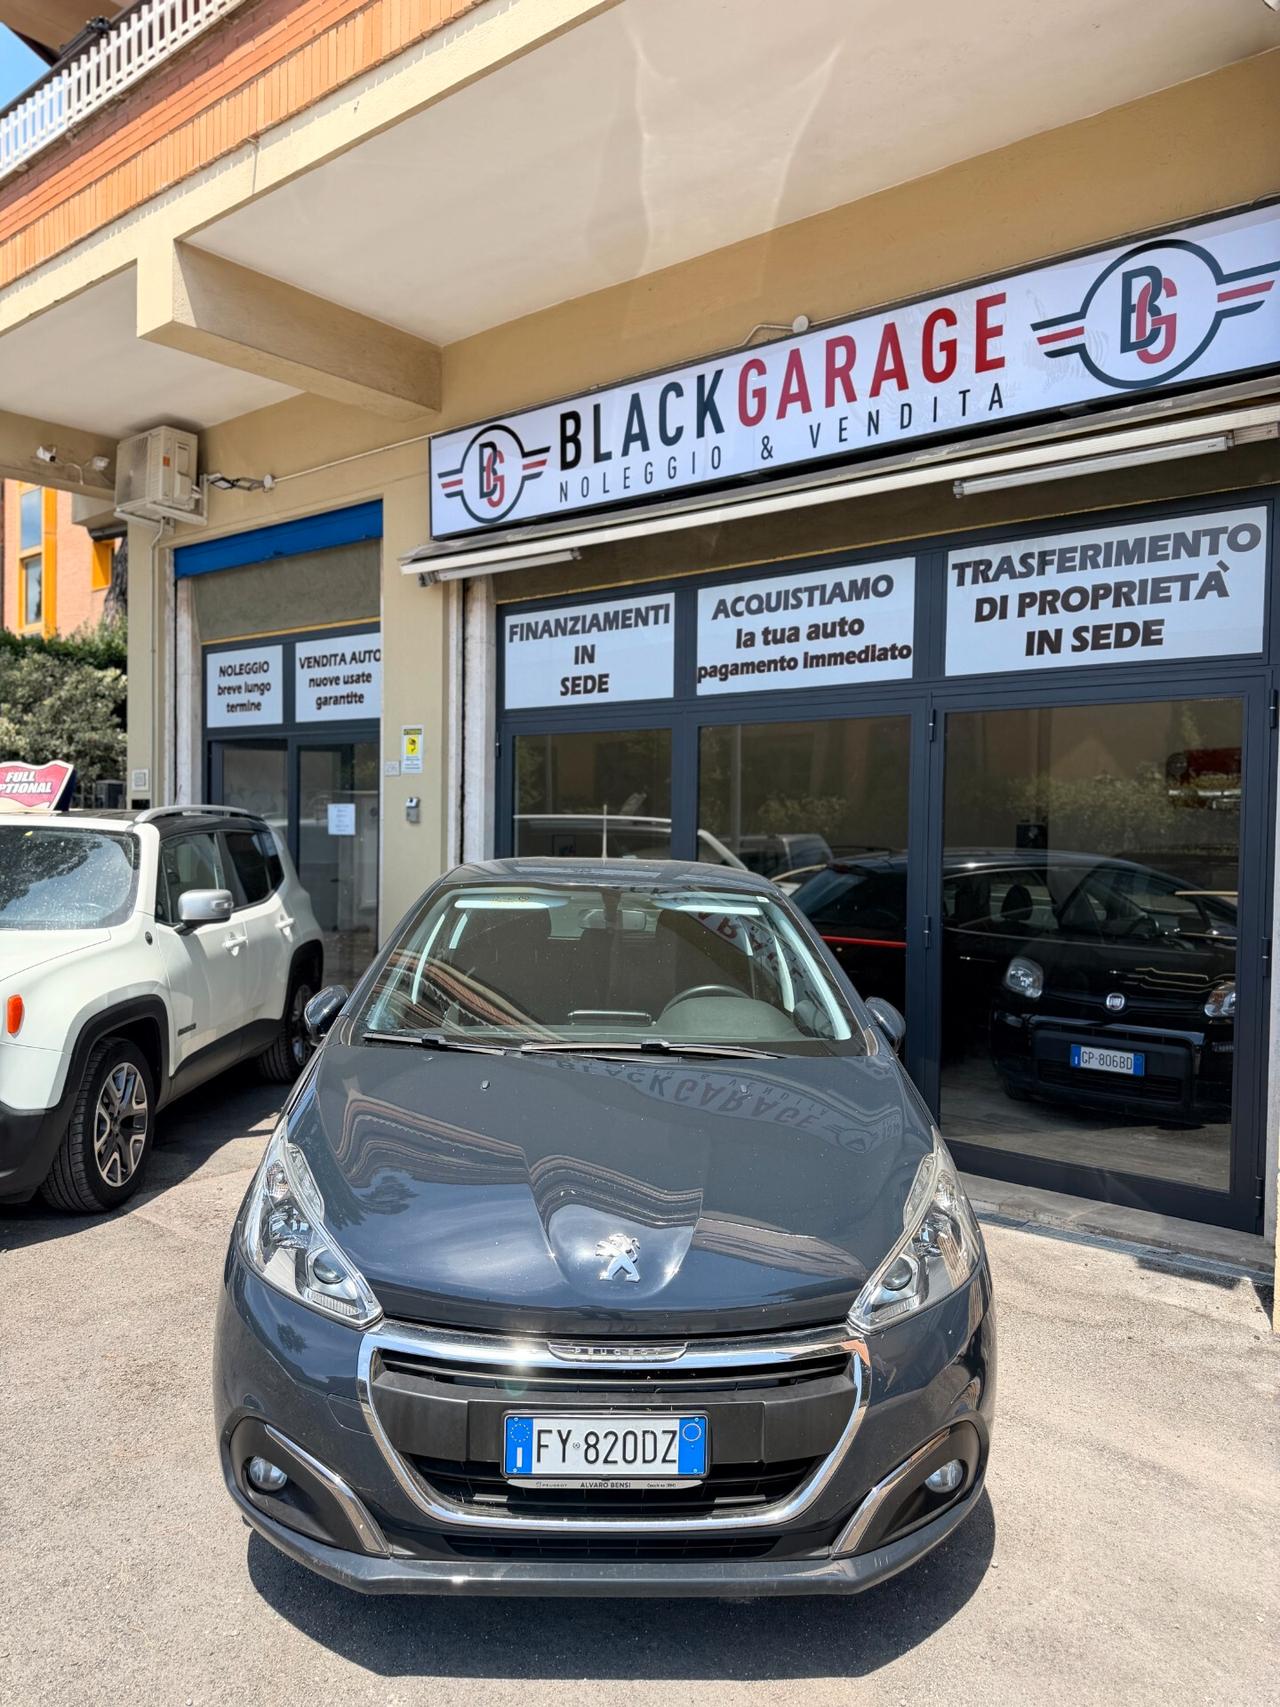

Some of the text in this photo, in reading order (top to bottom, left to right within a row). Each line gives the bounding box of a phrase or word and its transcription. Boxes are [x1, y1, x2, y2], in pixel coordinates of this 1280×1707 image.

[559, 382, 1003, 503] NOLEGGIO & VENDITA
[951, 522, 1262, 588] TRASFERIMENTO
[711, 573, 895, 621] ACQUISTIAMO
[974, 559, 1231, 623] DI PROPRIETÀ
[508, 602, 671, 643] FINANZIAMENTI
[735, 616, 866, 650] la tua auto
[1025, 618, 1166, 657] IN SEDE
[298, 648, 381, 671] VENDITA AUTO
[573, 644, 596, 666] IN
[697, 642, 912, 684] pagamento immediato
[218, 660, 270, 678] NOLEGGIO
[308, 671, 373, 689] nuove usate
[217, 681, 272, 697] breve lungo
[559, 672, 610, 697] SEDE
[226, 700, 262, 714] termine
[315, 691, 365, 711] garantite
[0, 782, 53, 794] PTIONAL
[5, 770, 36, 782] FULL
